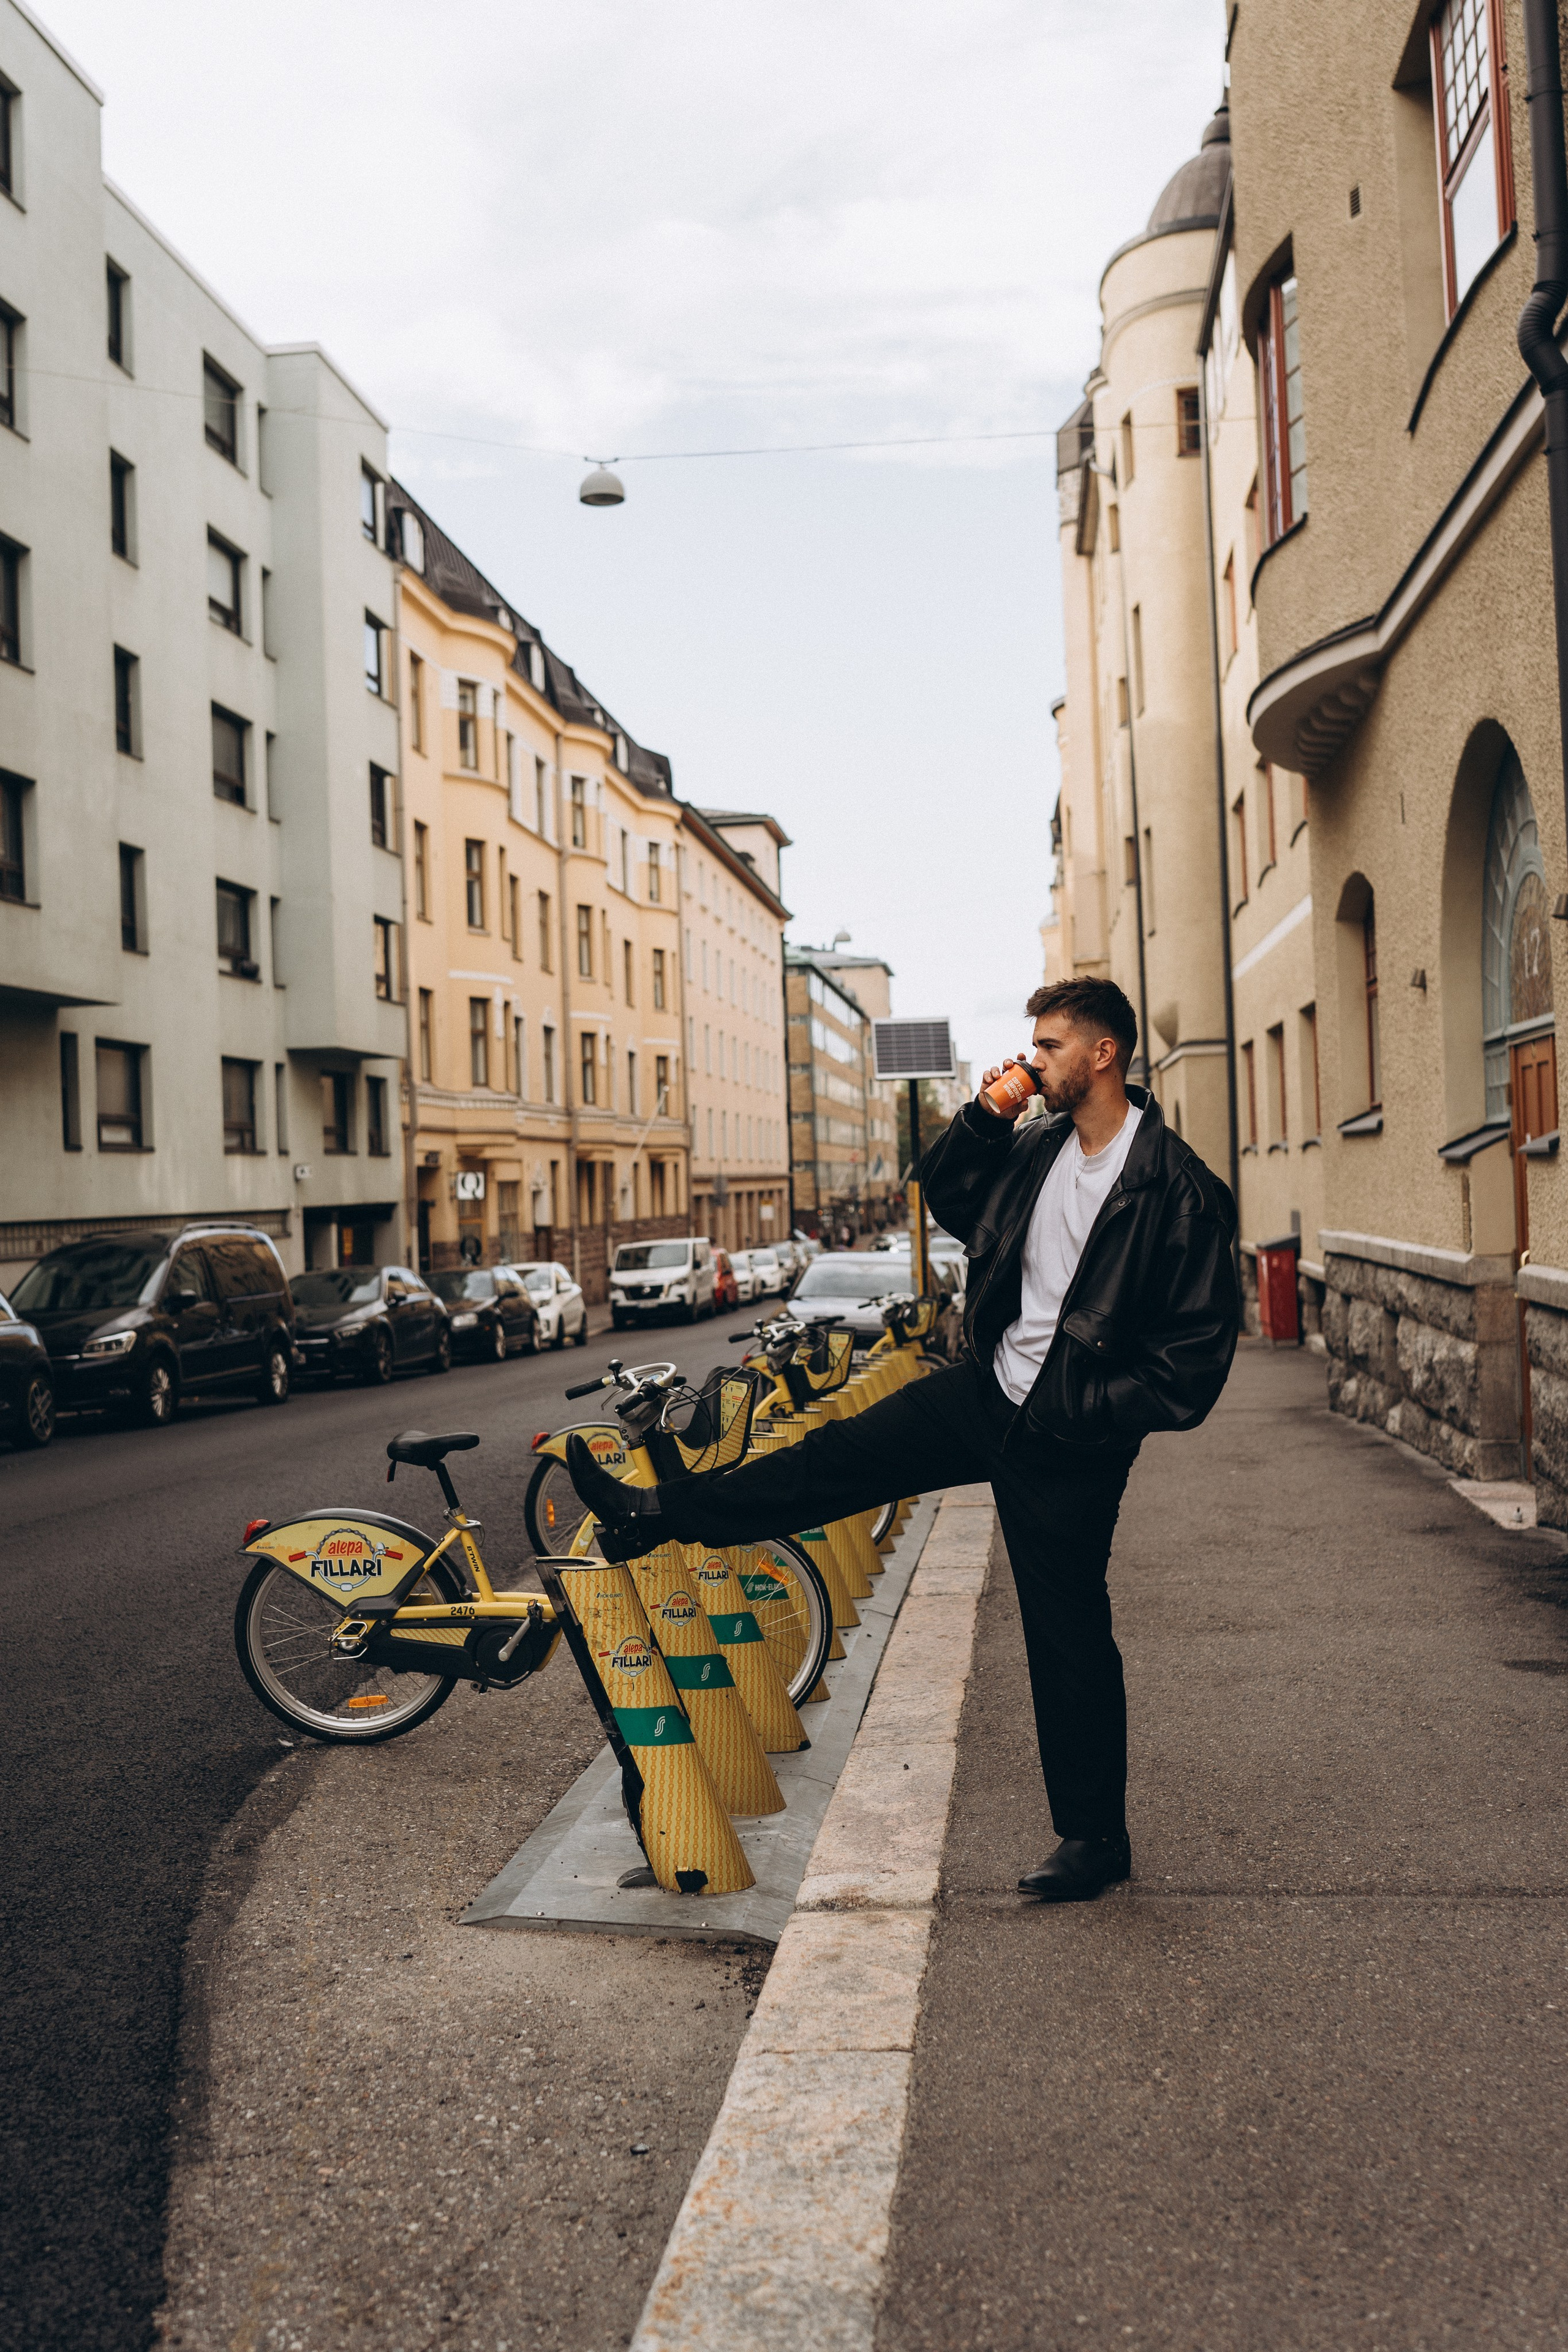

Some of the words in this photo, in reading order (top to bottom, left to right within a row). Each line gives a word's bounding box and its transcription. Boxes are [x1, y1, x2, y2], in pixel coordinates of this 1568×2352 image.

[1523, 927, 1540, 979] 17
[1003, 1084, 1015, 1099] WOMEN
[1012, 1077, 1025, 1093] COFFEE
[461, 1172, 480, 1200] Q
[590, 1440, 613, 1451] alepa
[597, 1452, 626, 1465] LARI
[328, 1540, 363, 1556] alepa
[311, 1559, 382, 1577] FILLARI
[698, 1570, 729, 1580] FILLARI
[450, 1606, 475, 1616] 2476
[662, 1607, 696, 1618] FILLARI
[623, 1643, 643, 1654] alepa
[611, 1654, 652, 1667] FILLARI
